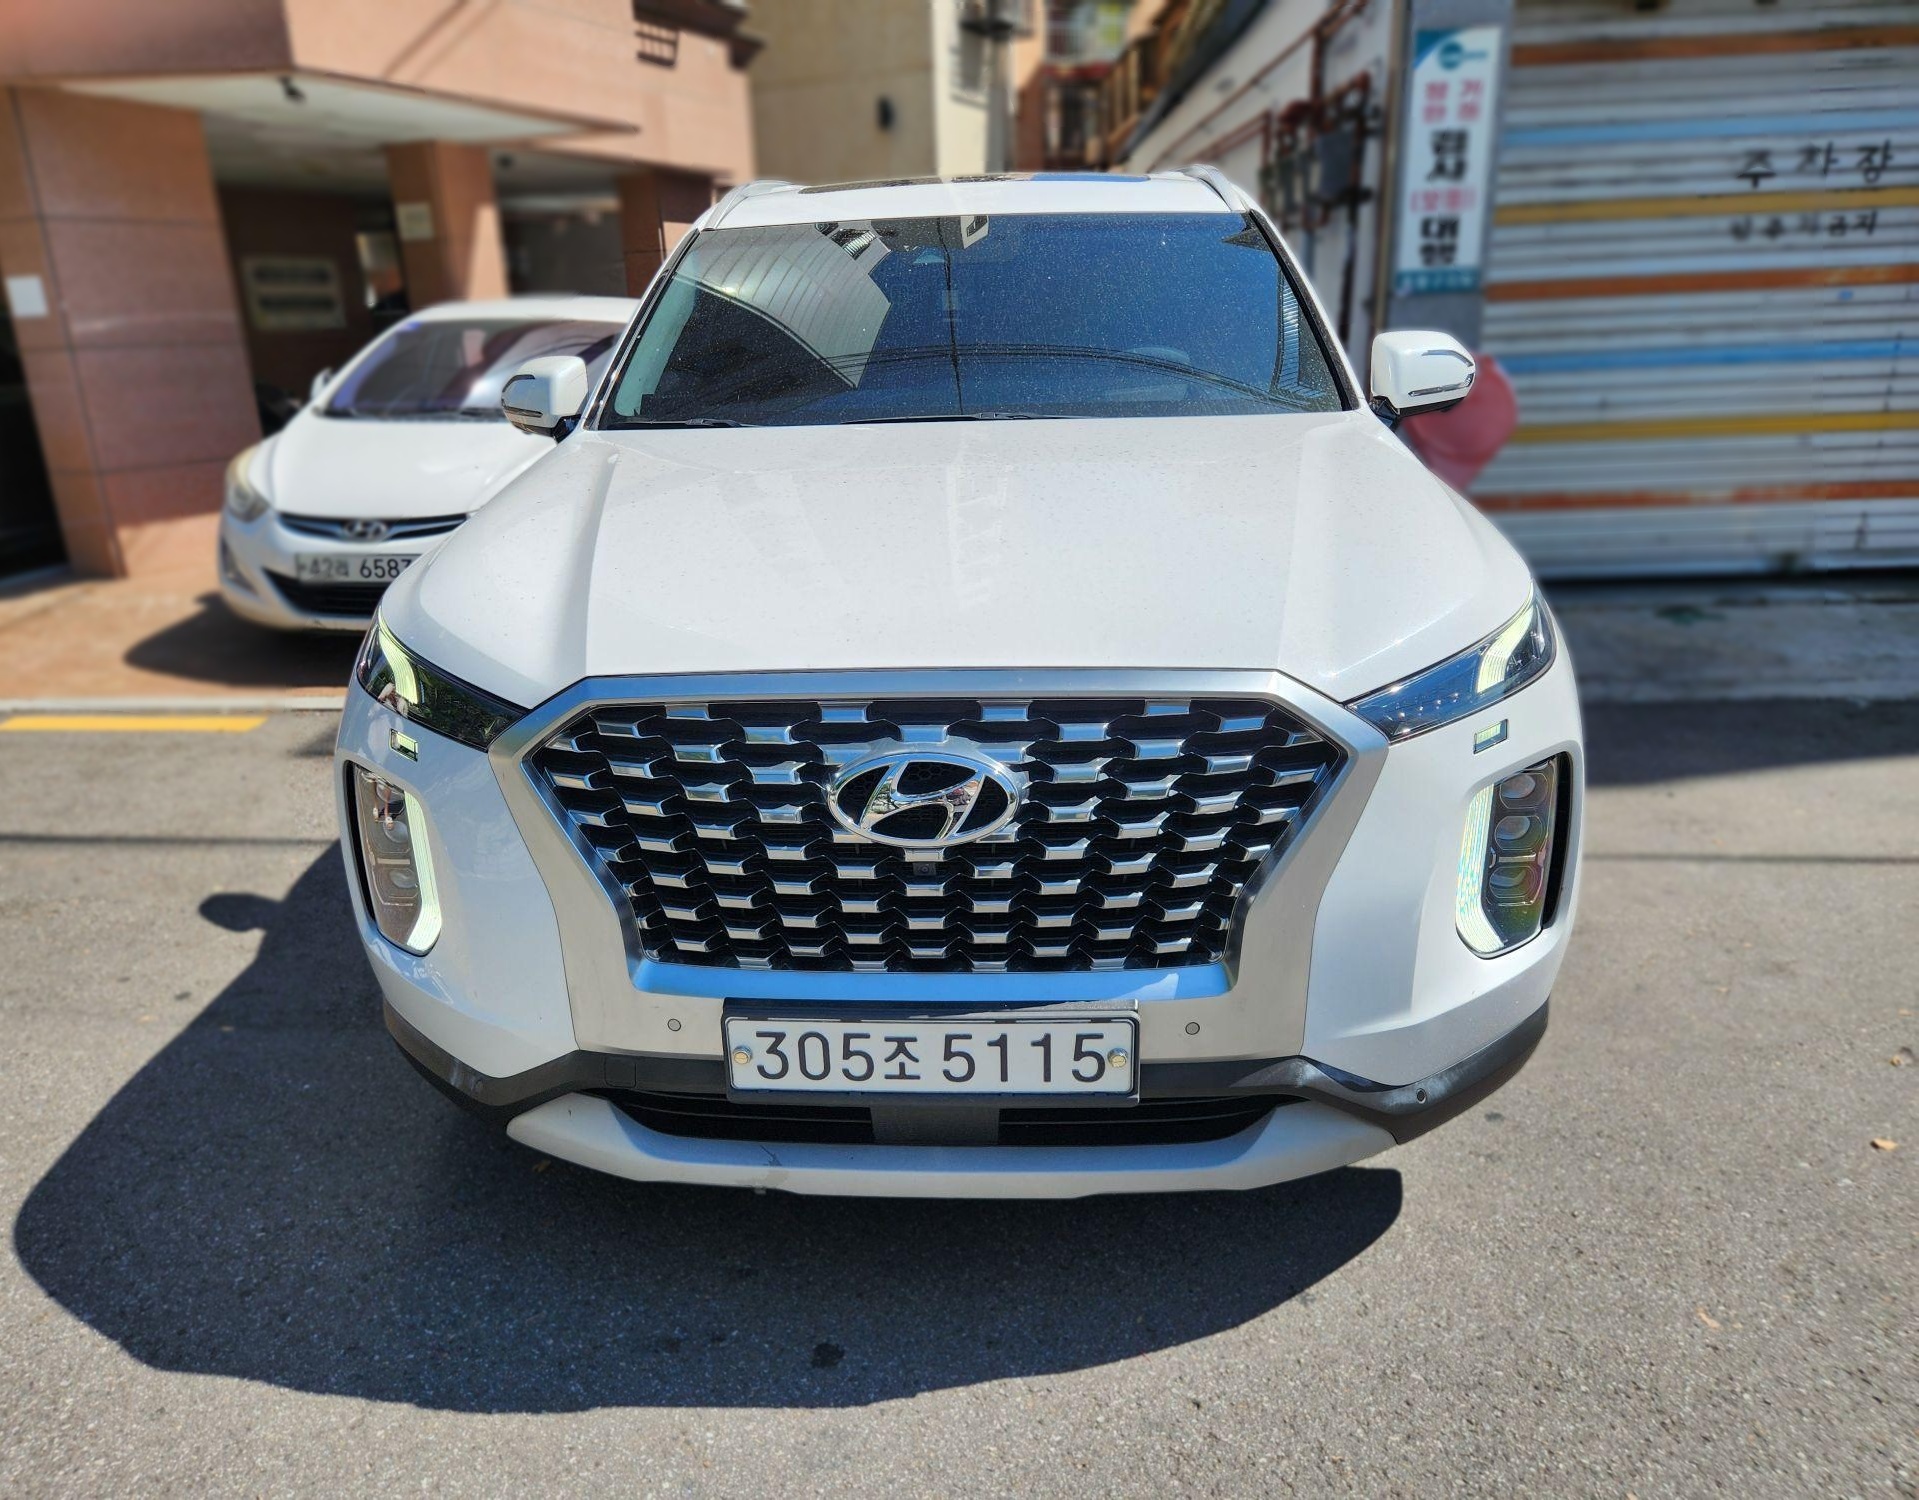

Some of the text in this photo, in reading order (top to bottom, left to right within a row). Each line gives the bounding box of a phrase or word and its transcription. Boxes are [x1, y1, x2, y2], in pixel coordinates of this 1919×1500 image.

[1736, 139, 1894, 189] 주차장
[755, 1030, 1106, 1083] 305조 5115
